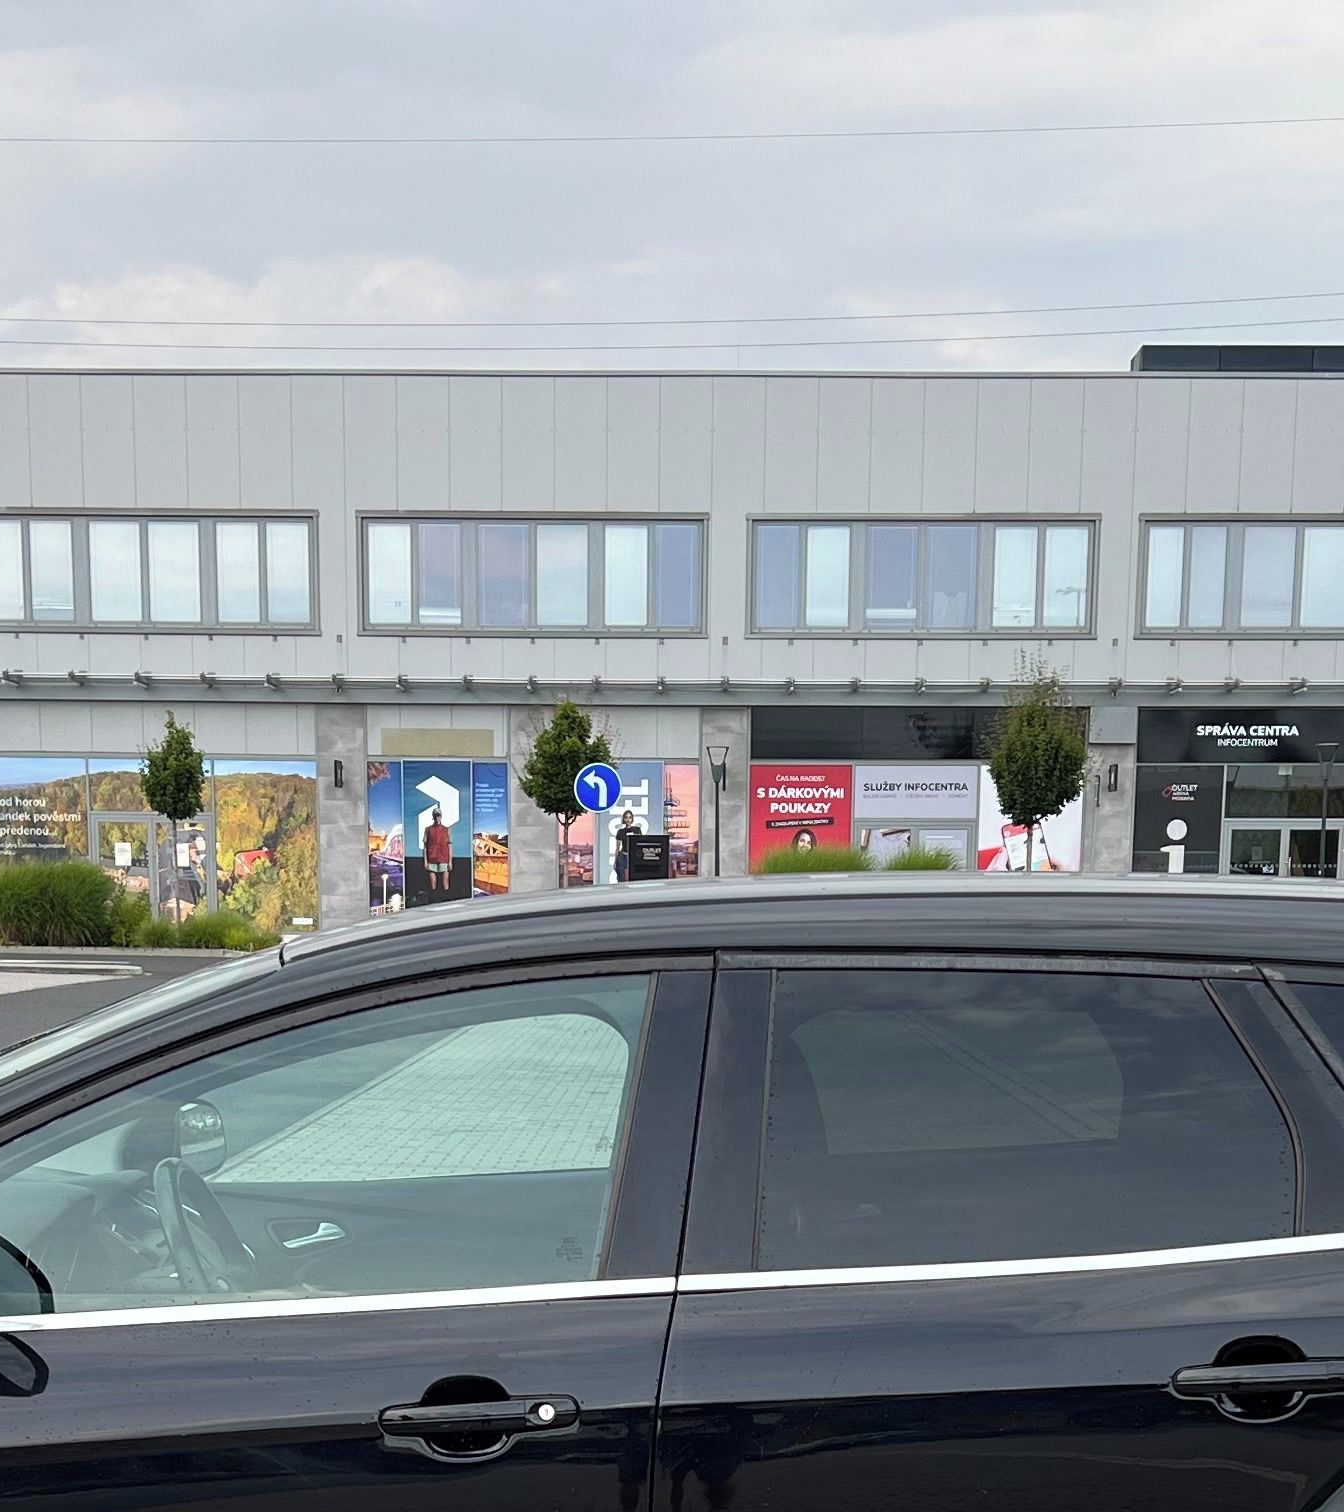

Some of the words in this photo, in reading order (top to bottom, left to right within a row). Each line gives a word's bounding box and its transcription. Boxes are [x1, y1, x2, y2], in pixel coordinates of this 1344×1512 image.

[1196, 722, 1247, 736] SPRÁVA
[1249, 725, 1299, 736] CENTRA
[1217, 738, 1278, 747] INFOCENTRUM
[756, 787, 765, 798] S
[768, 785, 844, 799] DÁRKOVÝMI
[863, 781, 902, 791] SLUŽBY
[904, 783, 968, 791] INFOCENTRA
[15, 796, 46, 807] horou
[770, 802, 831, 814] POUKAZY
[34, 810, 81, 823] pověstmi
